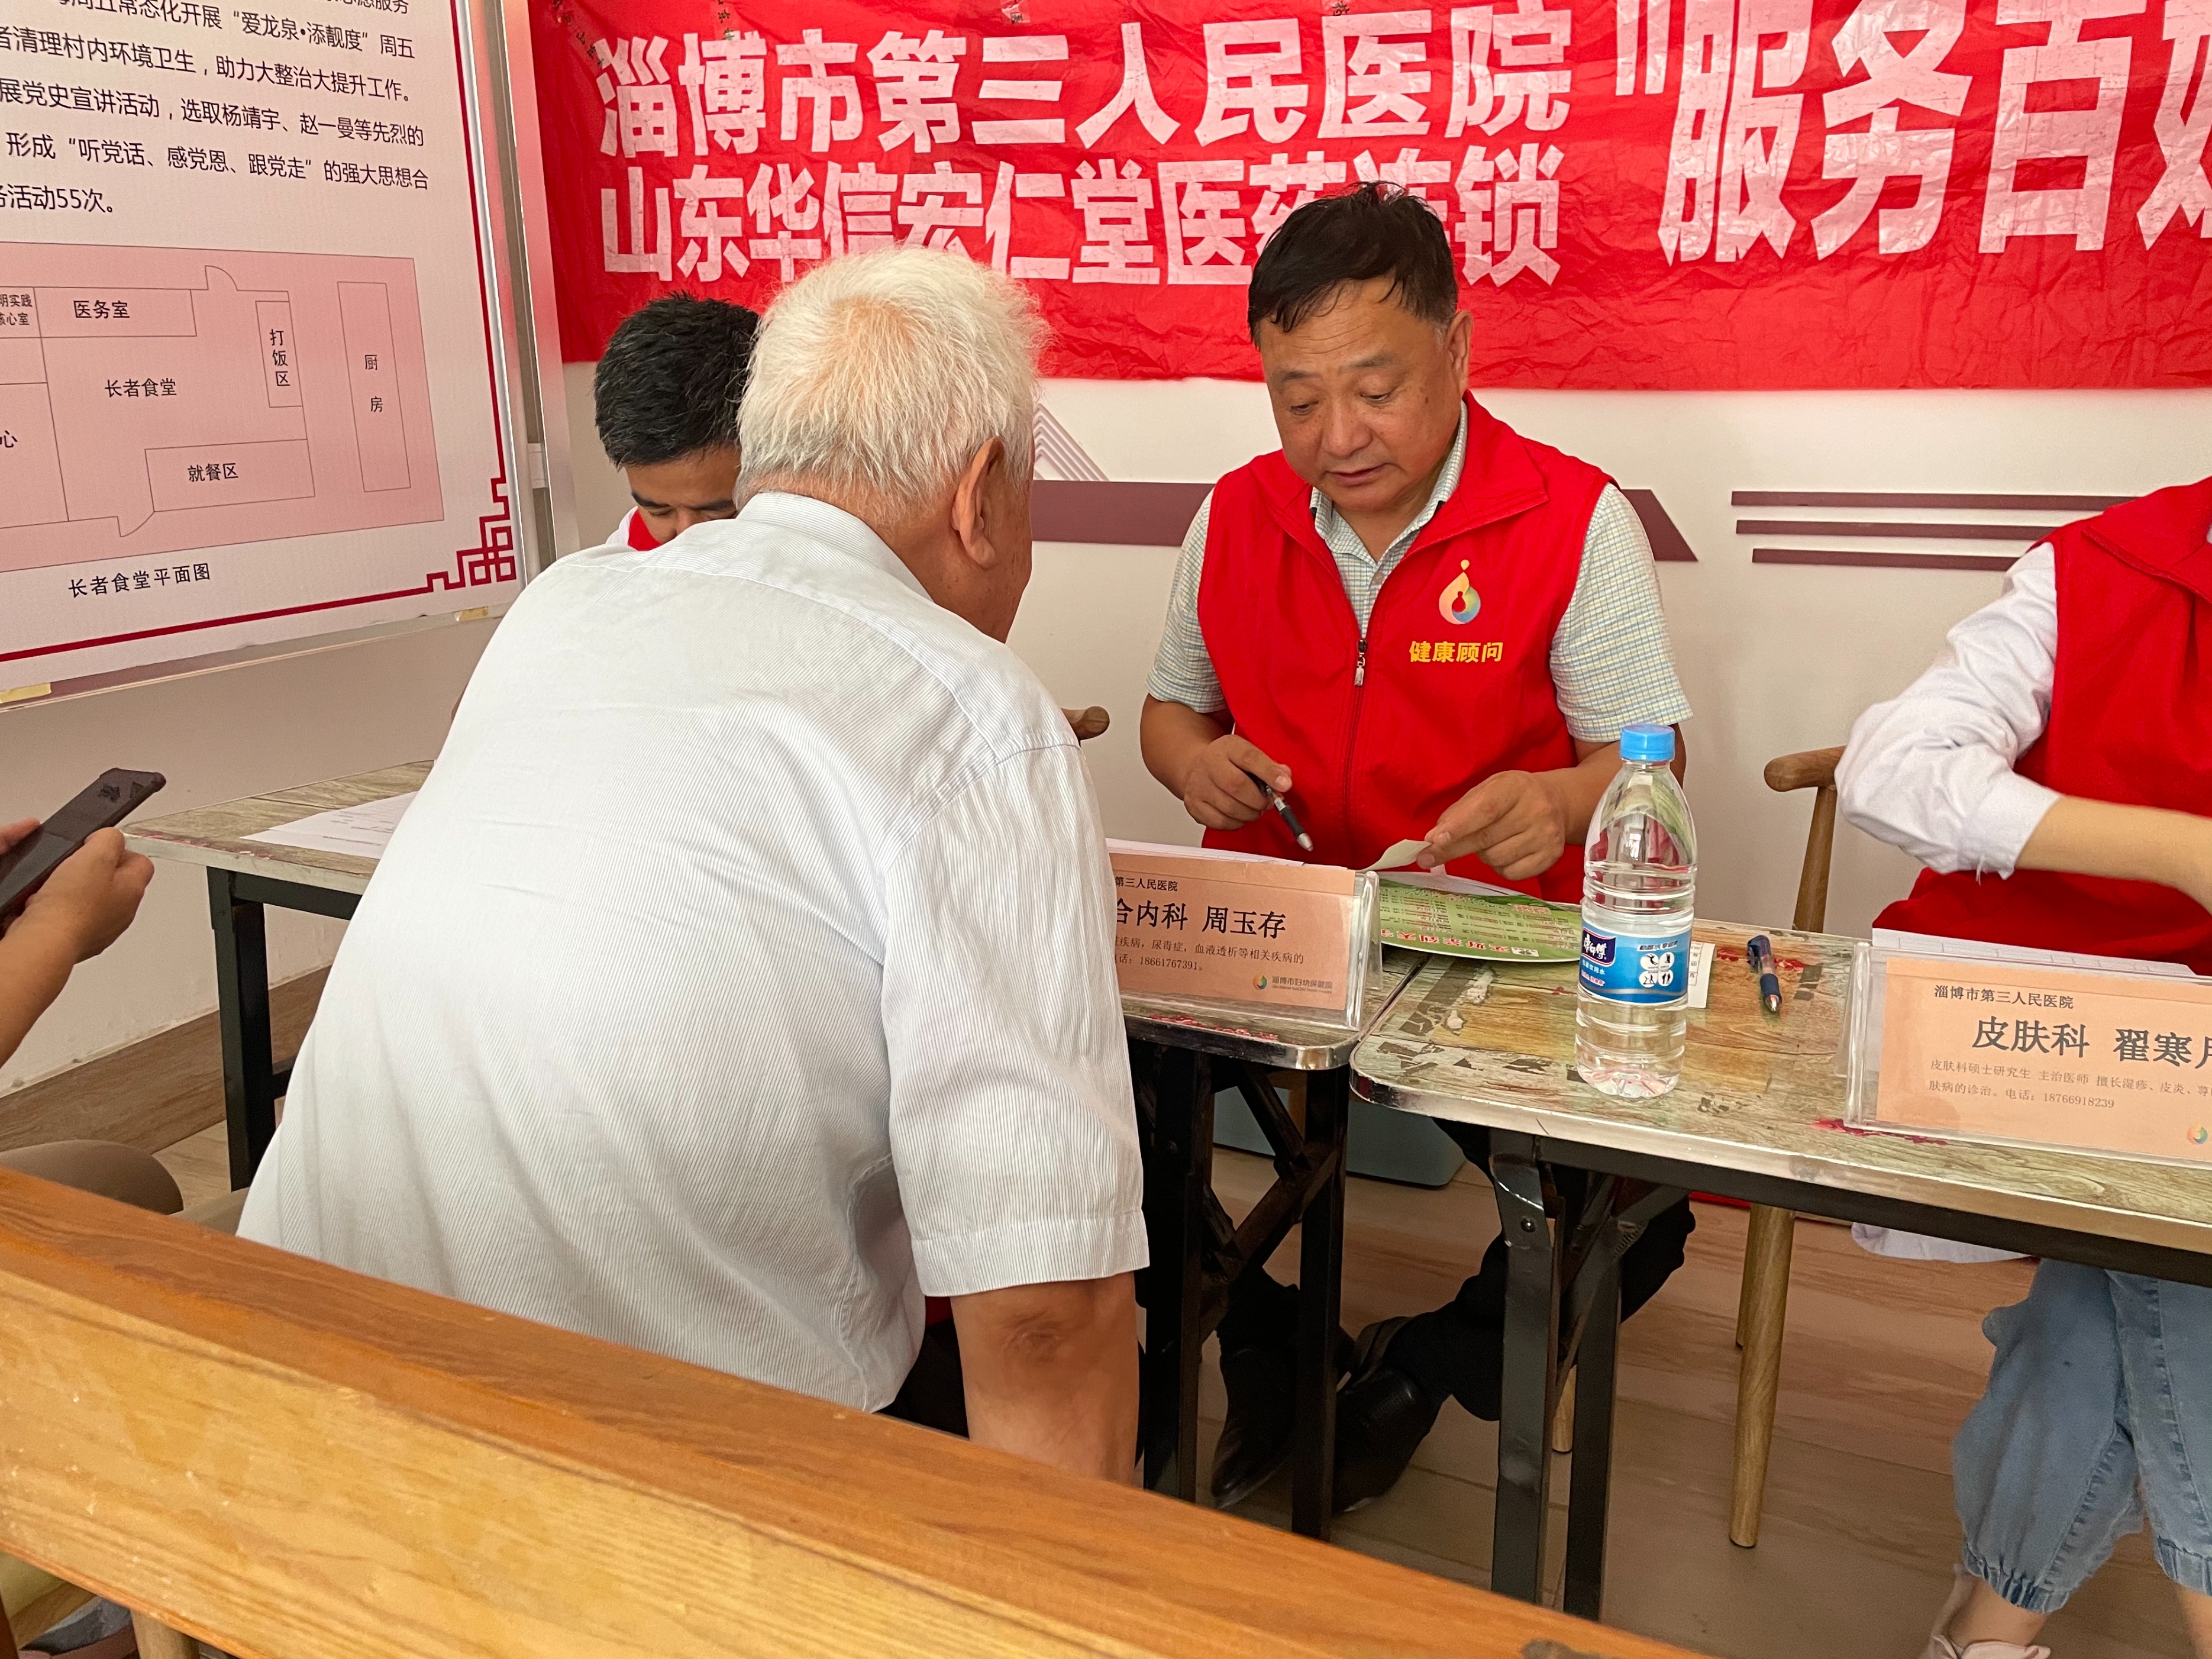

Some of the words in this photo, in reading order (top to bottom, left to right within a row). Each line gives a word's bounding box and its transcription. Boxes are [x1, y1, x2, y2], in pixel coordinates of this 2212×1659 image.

[595, 0, 1572, 159] 淄博市第三人民医院
[0, 78, 424, 147] 展党史宣讲活动，选取杨靖宇、赵一曼等先烈的
[73, 299, 130, 319] 医务室
[269, 328, 290, 386] 打饭区
[105, 377, 177, 398] 长者食堂
[187, 462, 239, 482] 就餐区
[68, 562, 211, 598] 长者食堂平面图
[1409, 640, 1504, 663] 健康顾问
[1115, 876, 1178, 892] 第三人民医院
[1202, 905, 1287, 940] 周玉存
[1934, 984, 2074, 1009] 淄博市第三人民医院
[1972, 1015, 2090, 1058] 皮肤科
[1930, 1059, 2031, 1080] 皮肤科硕士研究生
[2038, 1070, 2089, 1085] 主治医师
